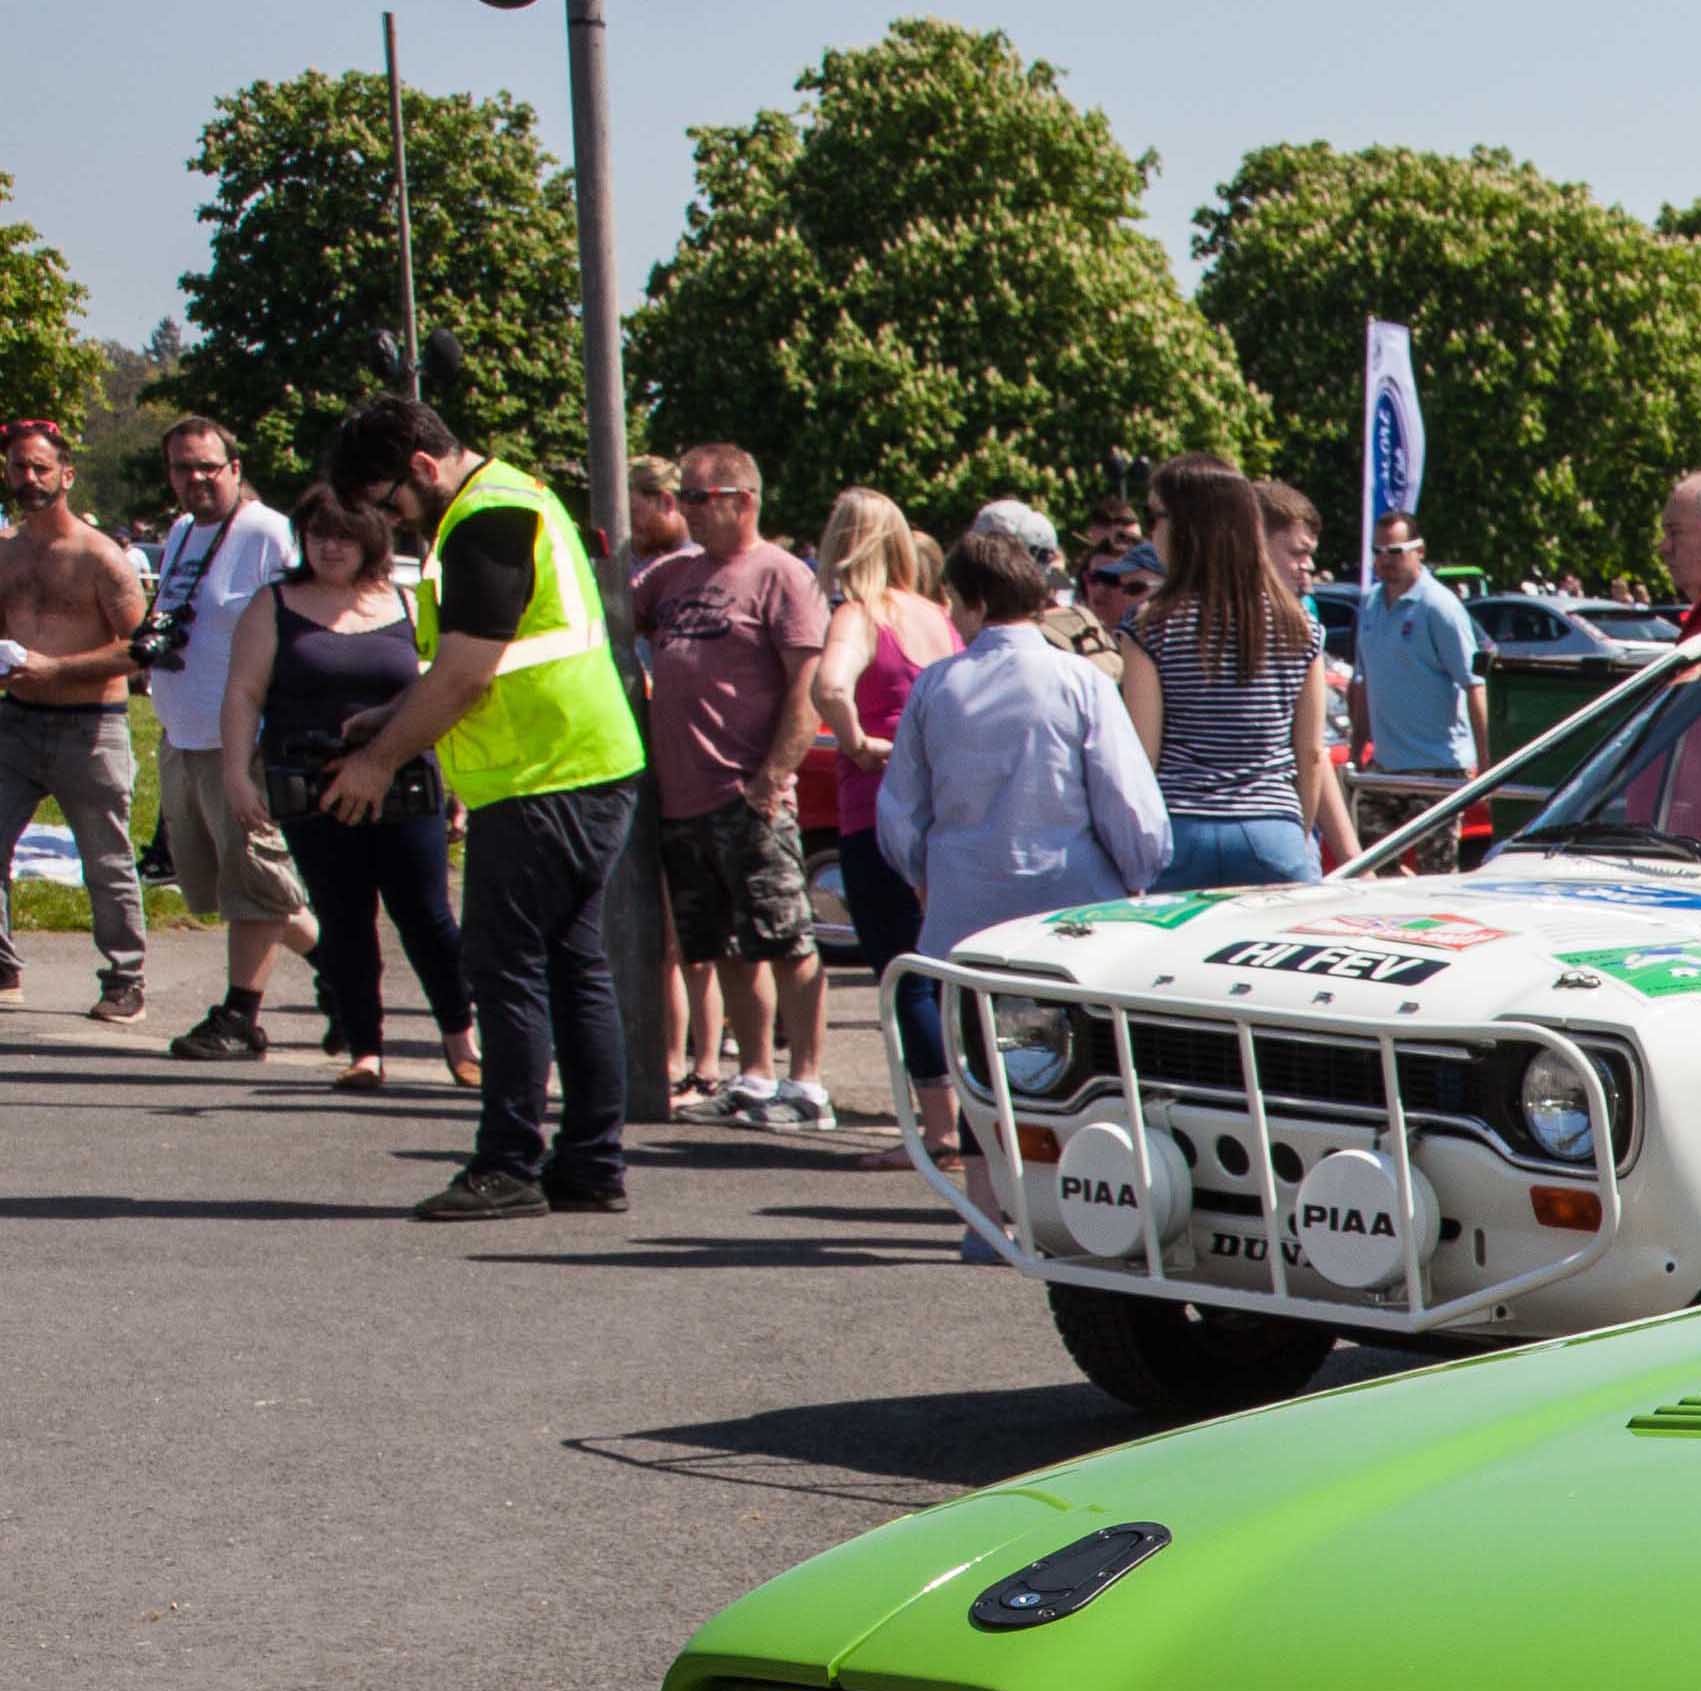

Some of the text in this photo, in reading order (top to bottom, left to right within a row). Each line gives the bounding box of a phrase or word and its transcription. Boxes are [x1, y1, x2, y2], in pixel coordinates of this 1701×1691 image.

[1227, 941, 1425, 981] HI FEV
[1061, 1176, 1138, 1208] PIAA
[1303, 1204, 1396, 1238] PIAA
